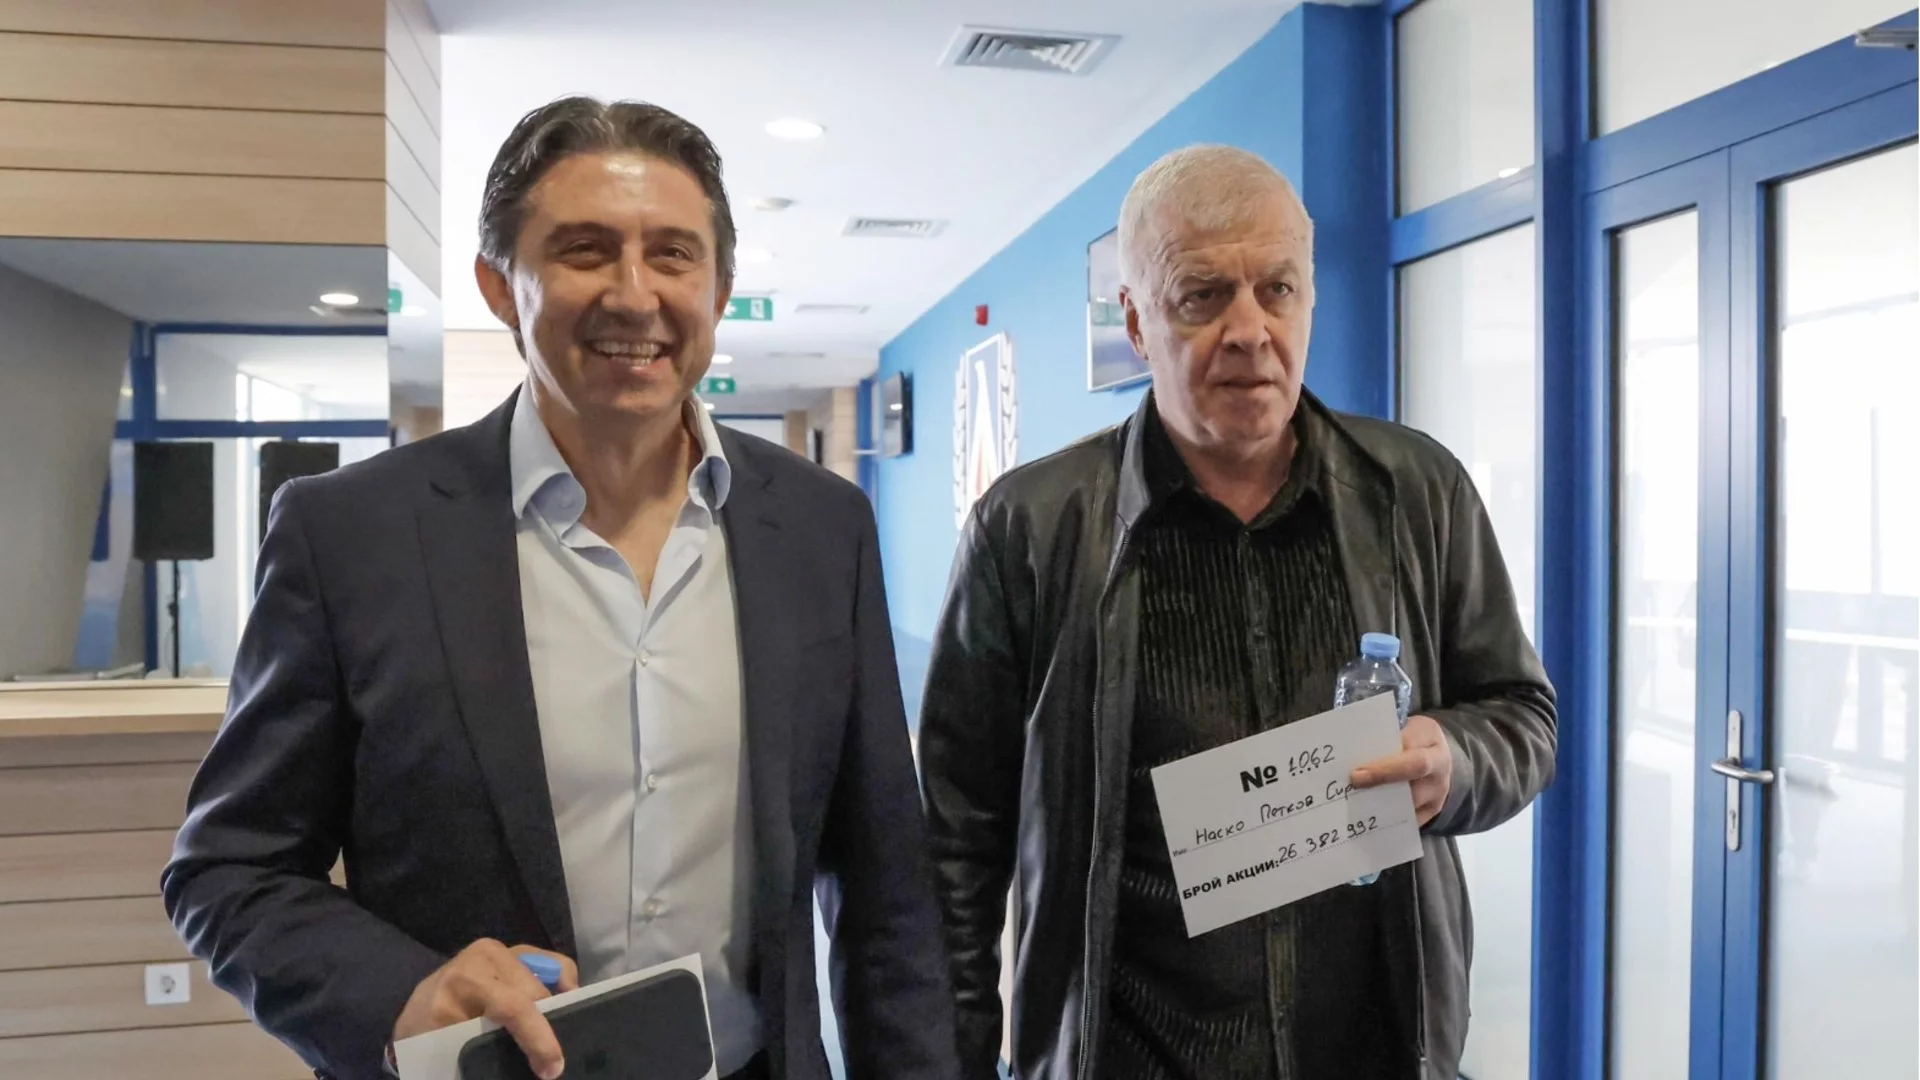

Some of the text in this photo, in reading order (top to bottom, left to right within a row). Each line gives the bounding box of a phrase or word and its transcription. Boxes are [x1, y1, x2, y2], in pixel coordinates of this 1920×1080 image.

[1288, 744, 1336, 773] 1062
[1195, 820, 1245, 845] Наско
[1260, 795, 1314, 822] Петков
[1182, 816, 1378, 900] БРОЙ АКЦИИ: 26 382 992
